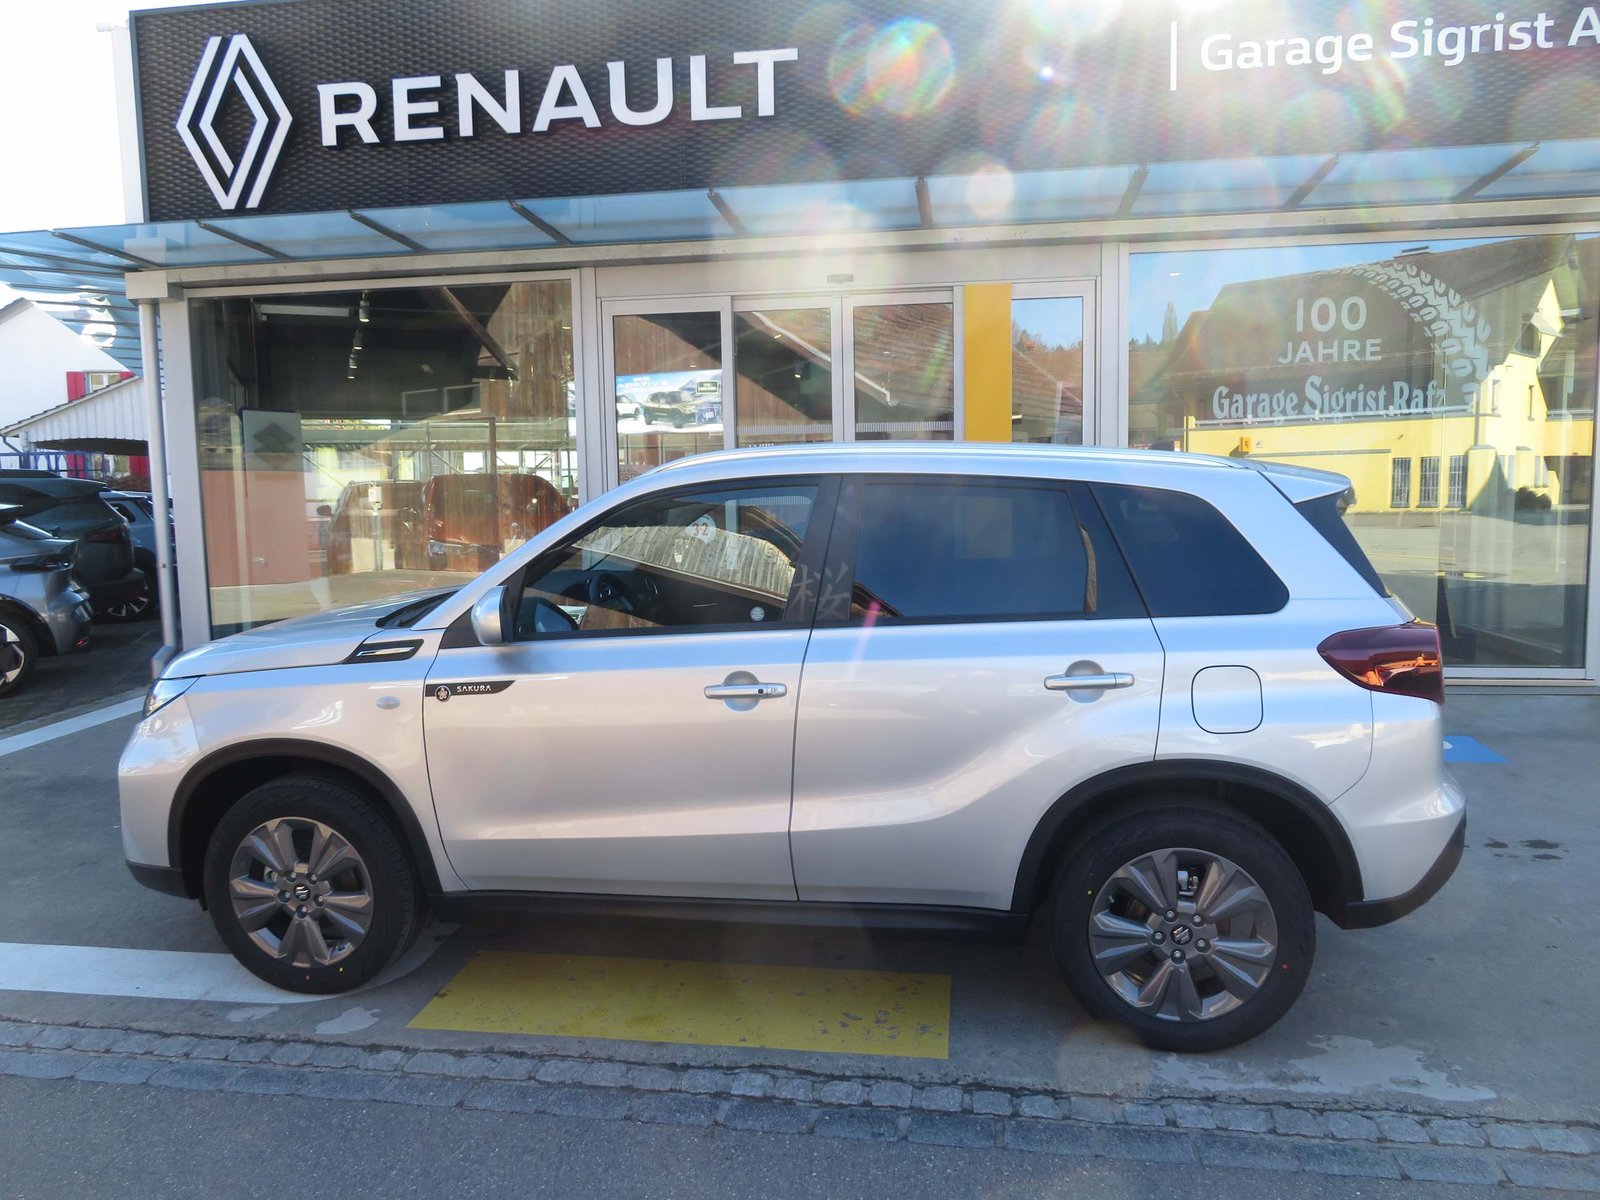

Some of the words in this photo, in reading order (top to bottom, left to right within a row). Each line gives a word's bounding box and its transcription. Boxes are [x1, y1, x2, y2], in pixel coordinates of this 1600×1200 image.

[1200, 30, 1373, 75] Garage
[1390, 12, 1554, 66] Sigrist
[317, 47, 798, 147] RENAULT
[1296, 296, 1368, 333] 100
[1278, 338, 1382, 364] JAHRE
[1212, 385, 1299, 425] Garage
[1303, 375, 1387, 424] Sigrist
[456, 685, 492, 693] SAKURA
